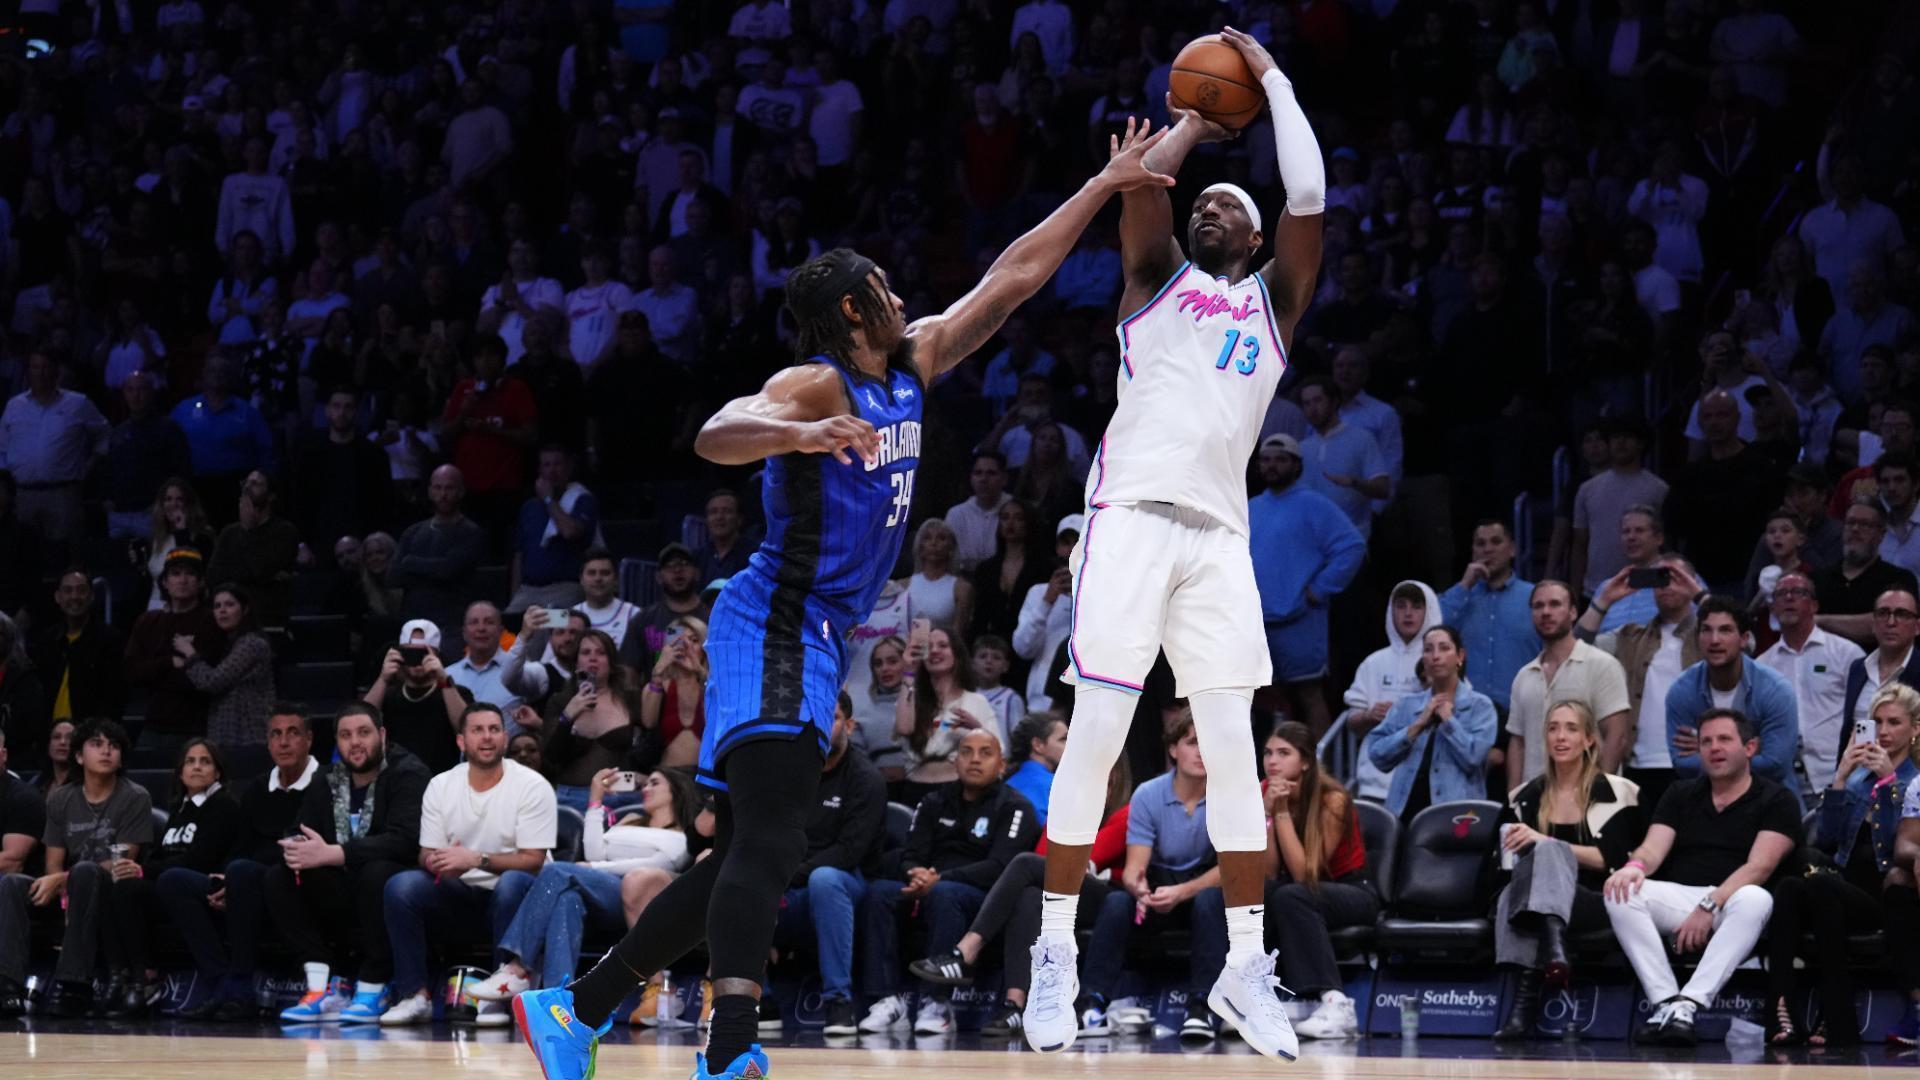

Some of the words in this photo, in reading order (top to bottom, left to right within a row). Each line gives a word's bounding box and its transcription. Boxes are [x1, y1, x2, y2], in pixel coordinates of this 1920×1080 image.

[1177, 289, 1260, 322] Miami
[1215, 329, 1260, 376] 13
[885, 469, 915, 528] 34
[1422, 988, 1497, 1008] Sotheby's
